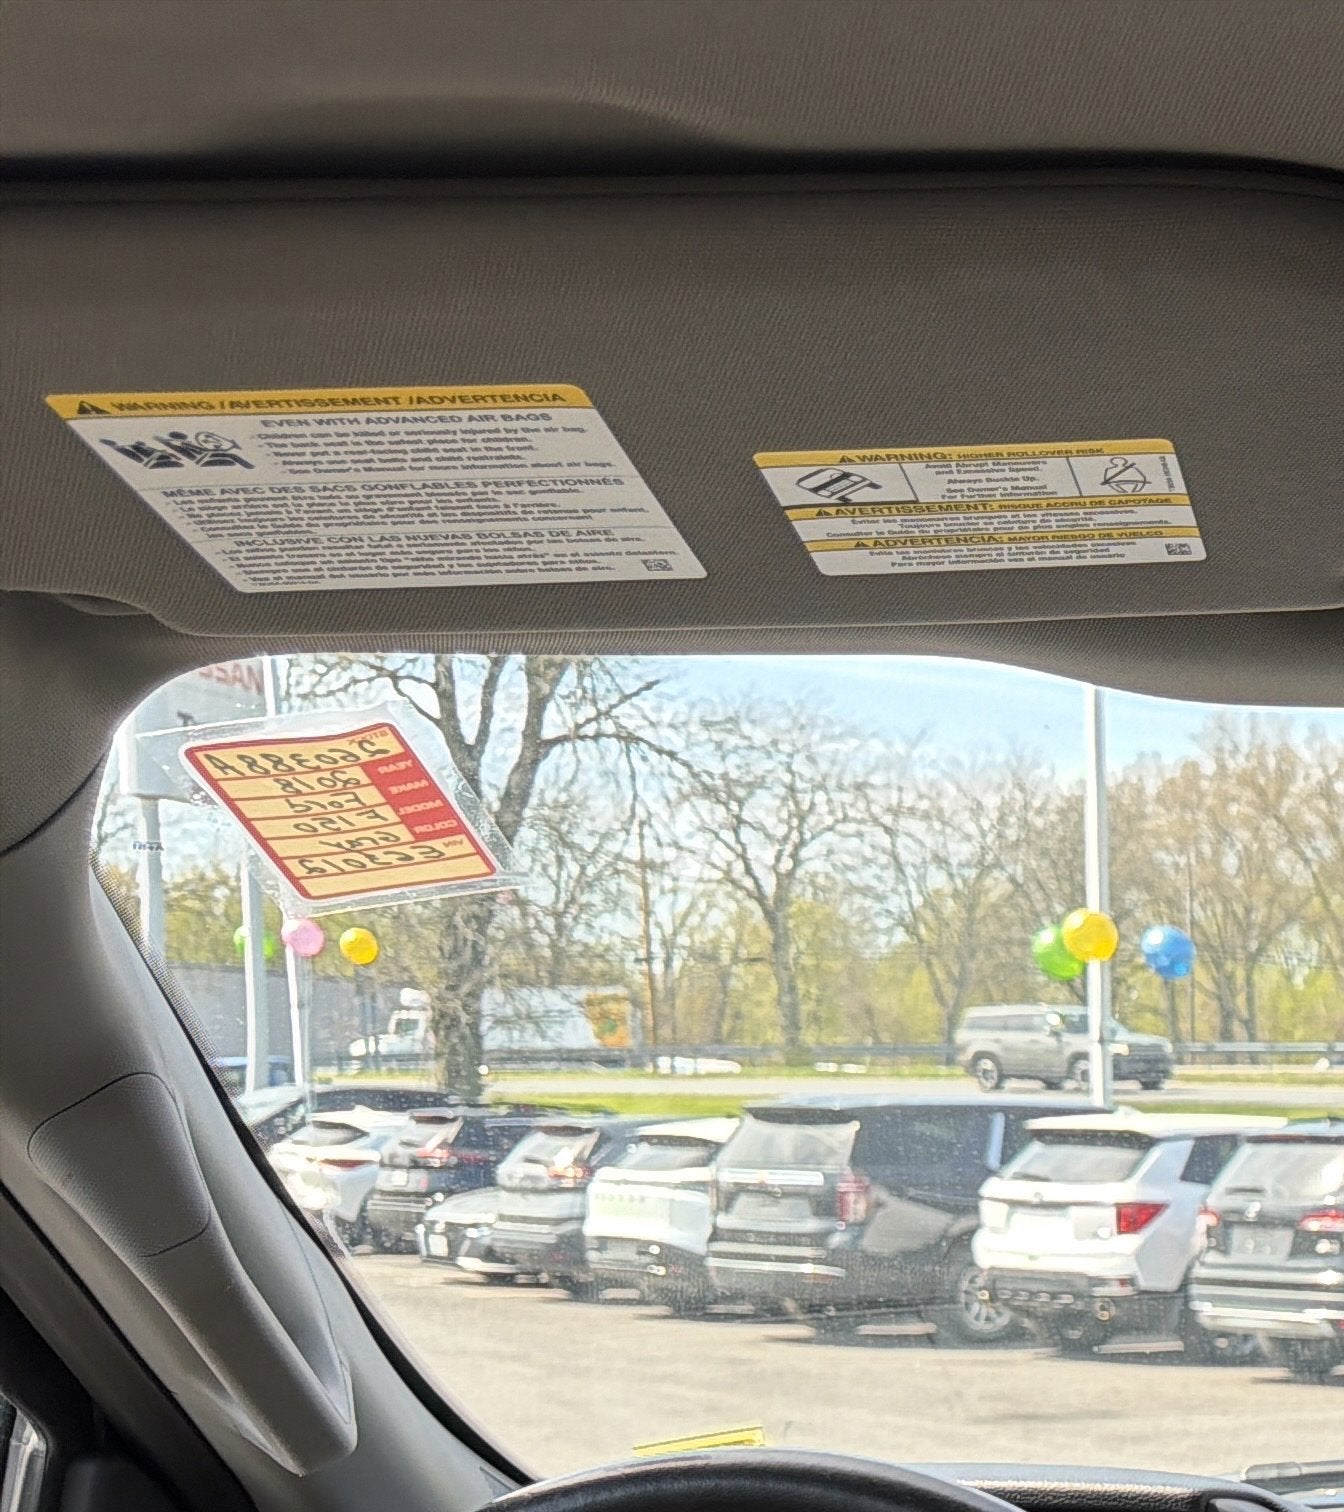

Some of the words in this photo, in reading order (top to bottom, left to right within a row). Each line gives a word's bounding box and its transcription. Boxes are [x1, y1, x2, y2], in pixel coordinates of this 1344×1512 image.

[112, 400, 215, 411] WARNING
[261, 419, 310, 427] EVEN
[314, 417, 361, 426] WITH
[365, 414, 463, 425] ADVANCED
[467, 414, 498, 423] AIR
[500, 412, 553, 422] BAGS
[855, 452, 953, 463] WARNING:
[957, 451, 1005, 459] HIGHER
[1007, 449, 1075, 457] ROLLOVER
[1076, 447, 1104, 455] RISK
[219, 486, 266, 496] AVEC
[268, 485, 306, 494] DES
[309, 484, 358, 493] SACS
[360, 481, 479, 492] GONFLABLES
[480, 477, 625, 489] PERFECTIONNÉS
[834, 502, 995, 515] AVERTISSEMENT:
[233, 537, 324, 547] INCLUSIVE
[326, 535, 365, 543] CON
[367, 534, 402, 542] LAS
[404, 532, 473, 541] NUEVAS
[475, 530, 545, 539] BOLSAS
[549, 530, 574, 538] DE
[576, 528, 615, 537] AIRE
[872, 535, 1004, 548] ADVERTENCIA:
